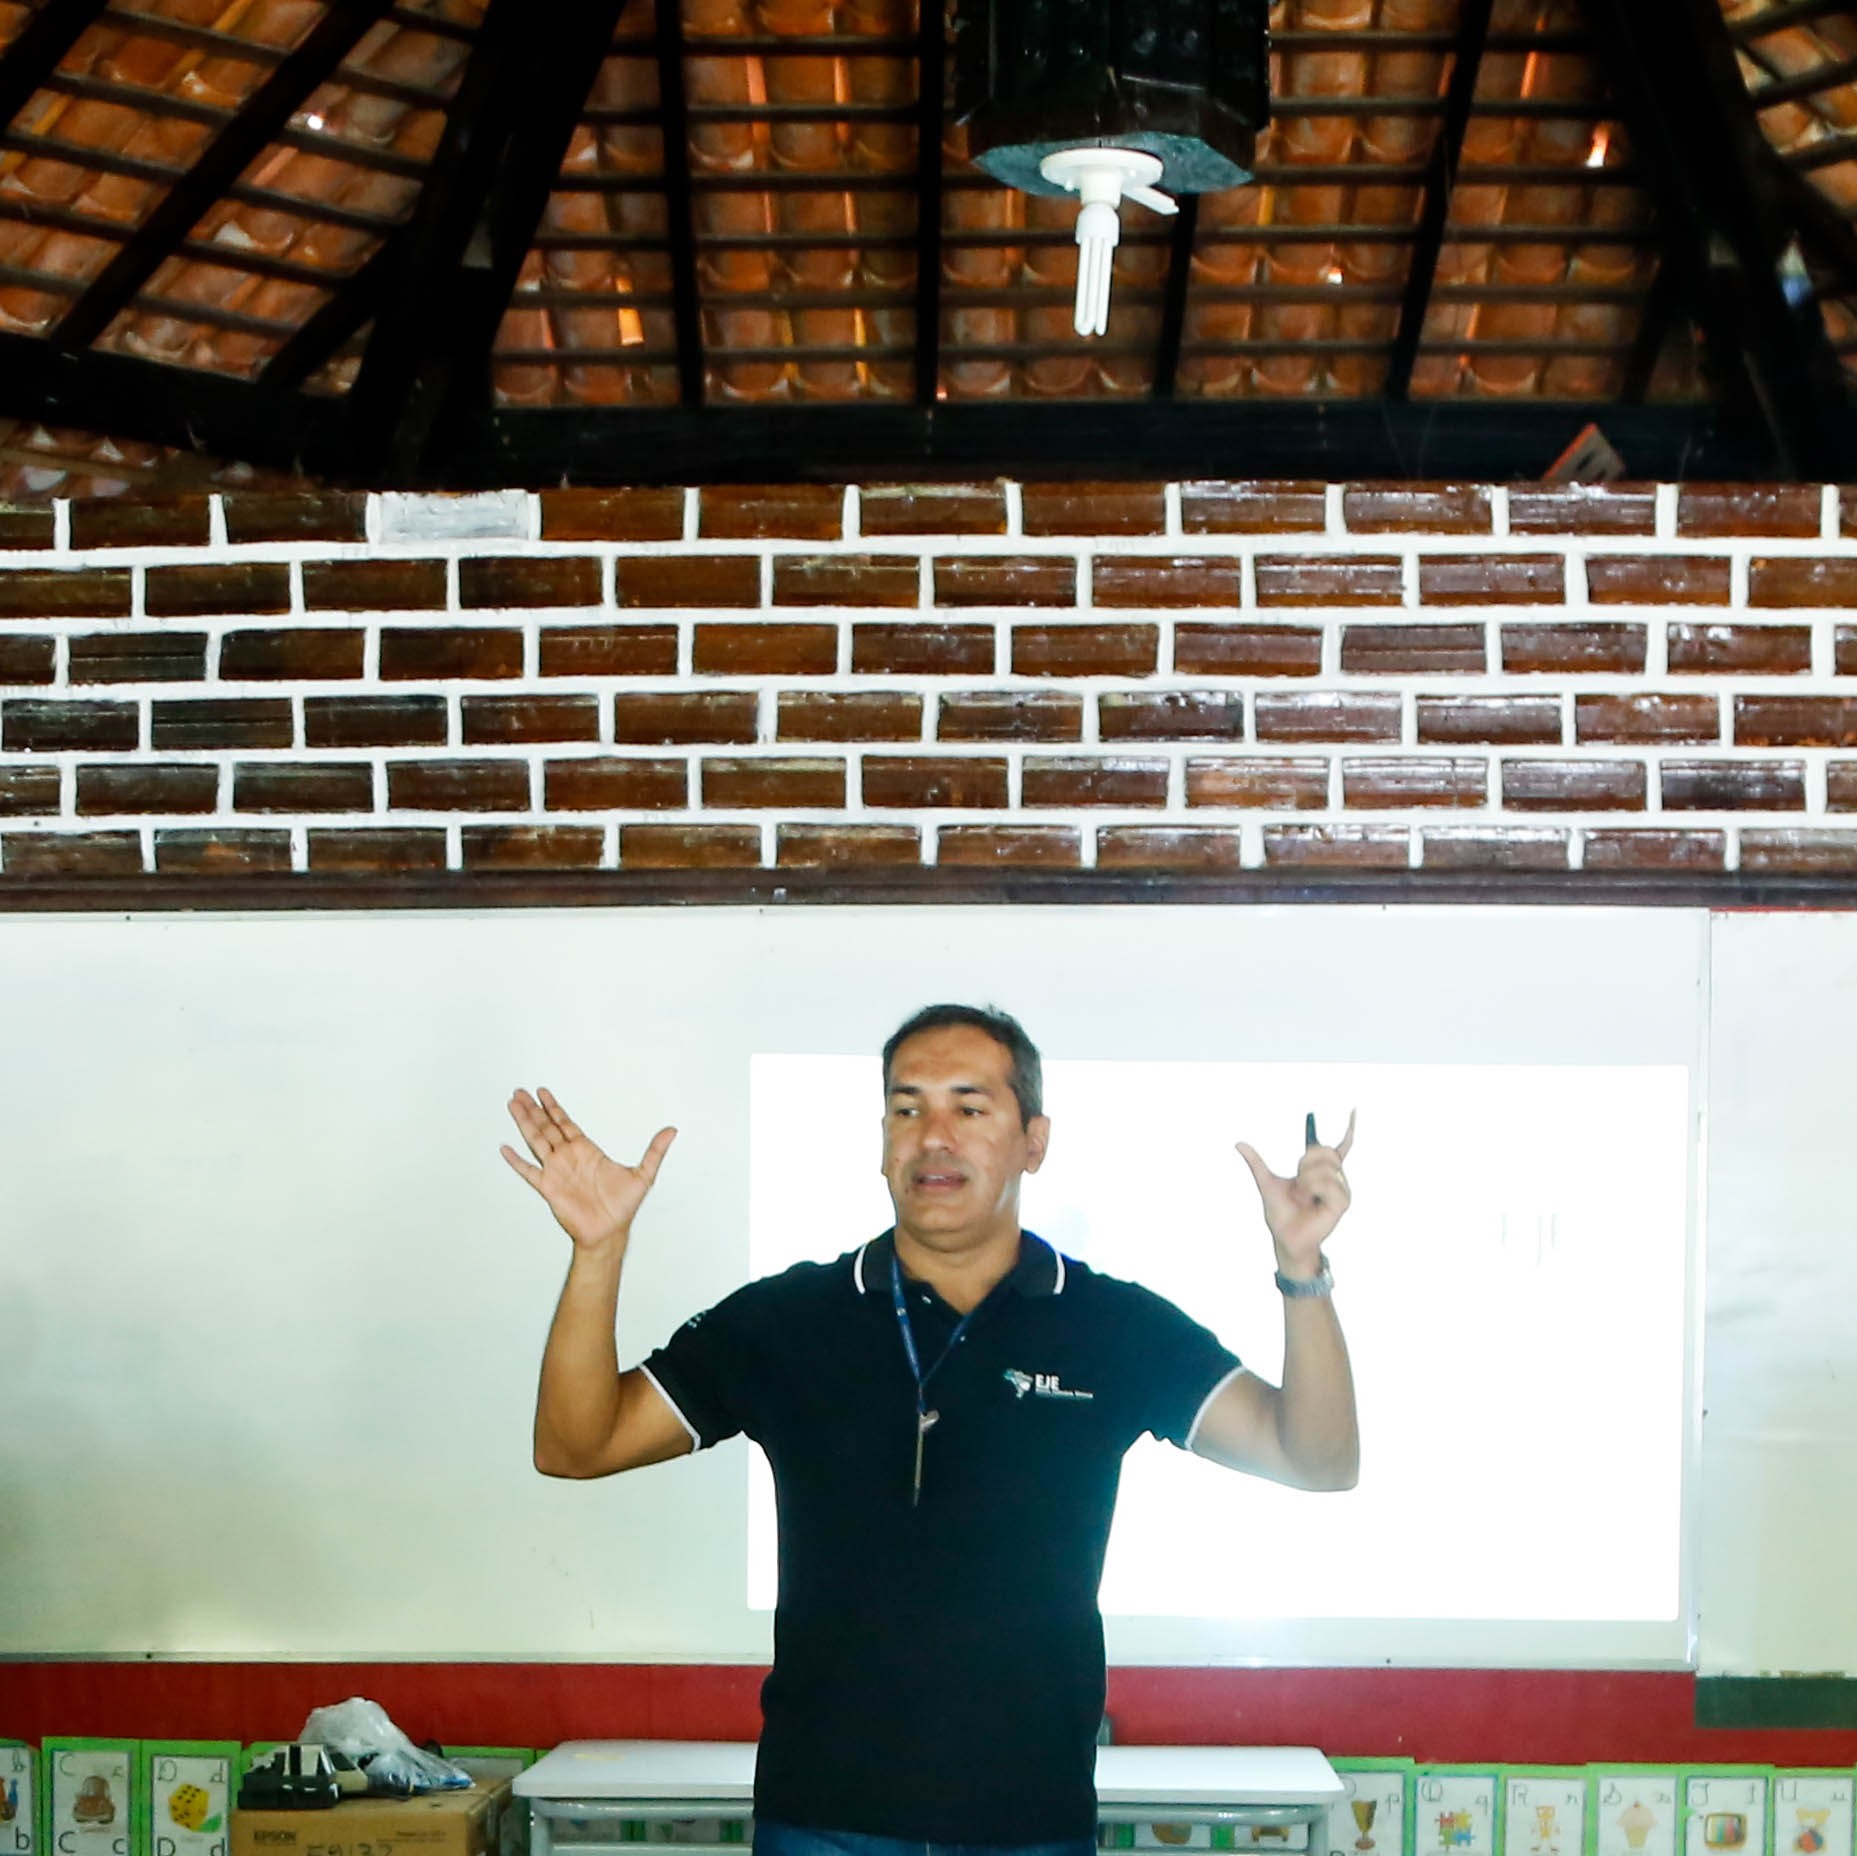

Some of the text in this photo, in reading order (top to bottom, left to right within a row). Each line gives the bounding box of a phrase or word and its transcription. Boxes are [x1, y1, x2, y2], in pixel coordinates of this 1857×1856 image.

[15, 1827, 30, 1850] b
[58, 1831, 125, 1855] C c
